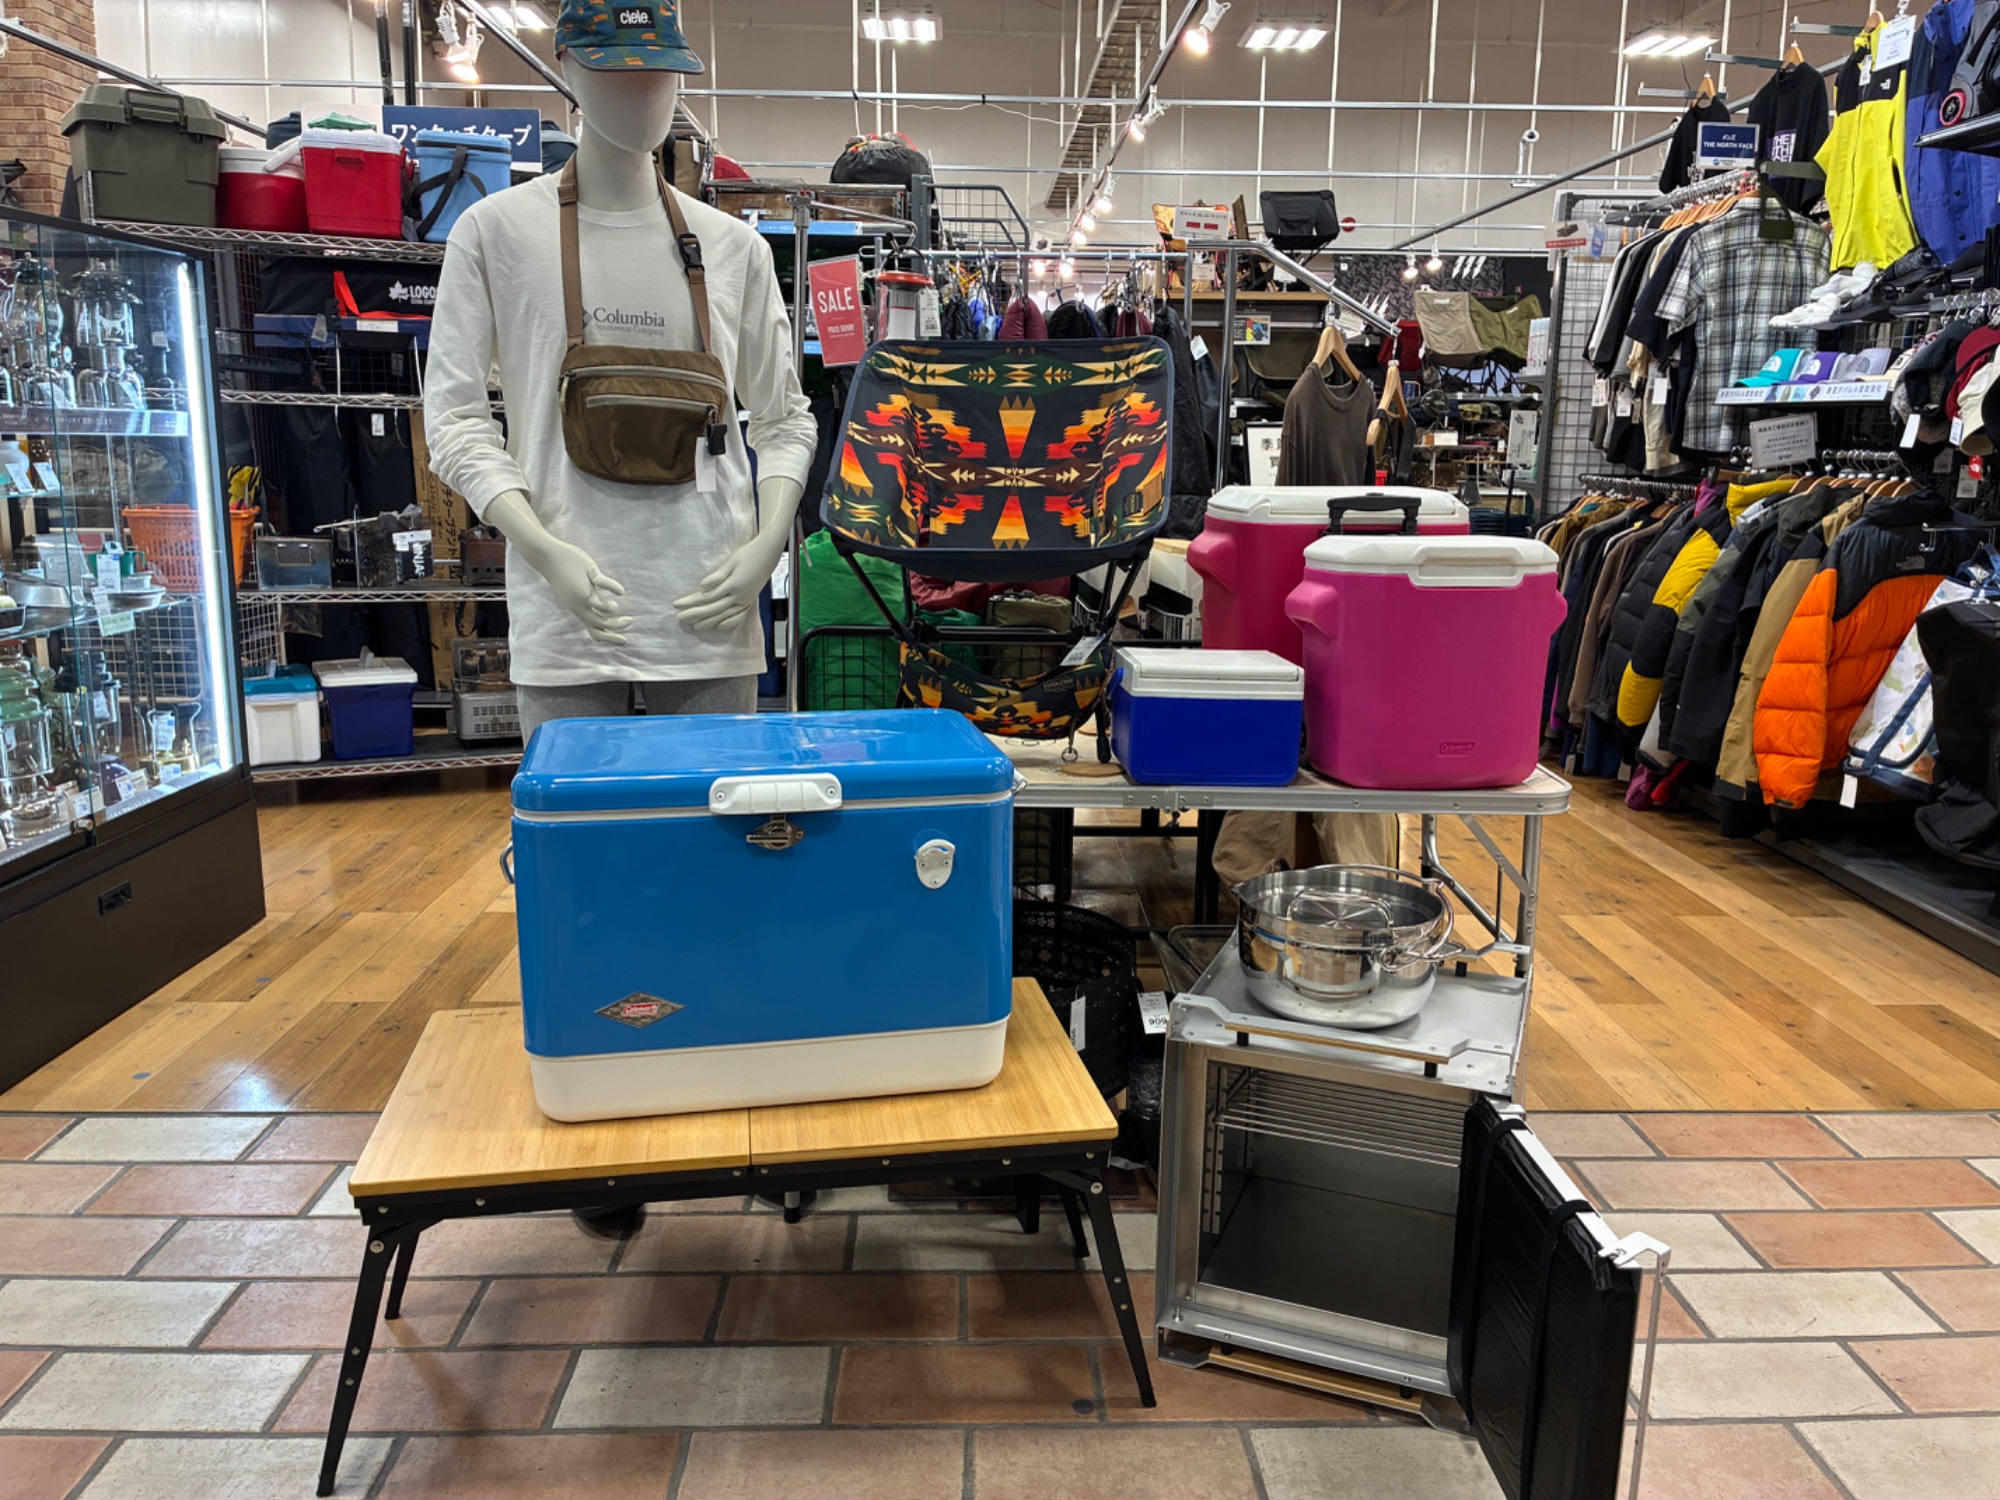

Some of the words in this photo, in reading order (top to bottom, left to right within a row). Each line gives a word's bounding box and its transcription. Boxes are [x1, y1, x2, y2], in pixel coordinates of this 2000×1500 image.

[1703, 141, 1716, 149] THE
[1716, 141, 1738, 149] NORTH
[1738, 142, 1753, 150] FACE
[409, 285, 437, 299] LOGO
[817, 286, 855, 313] SALE
[593, 307, 666, 327] Columbia
